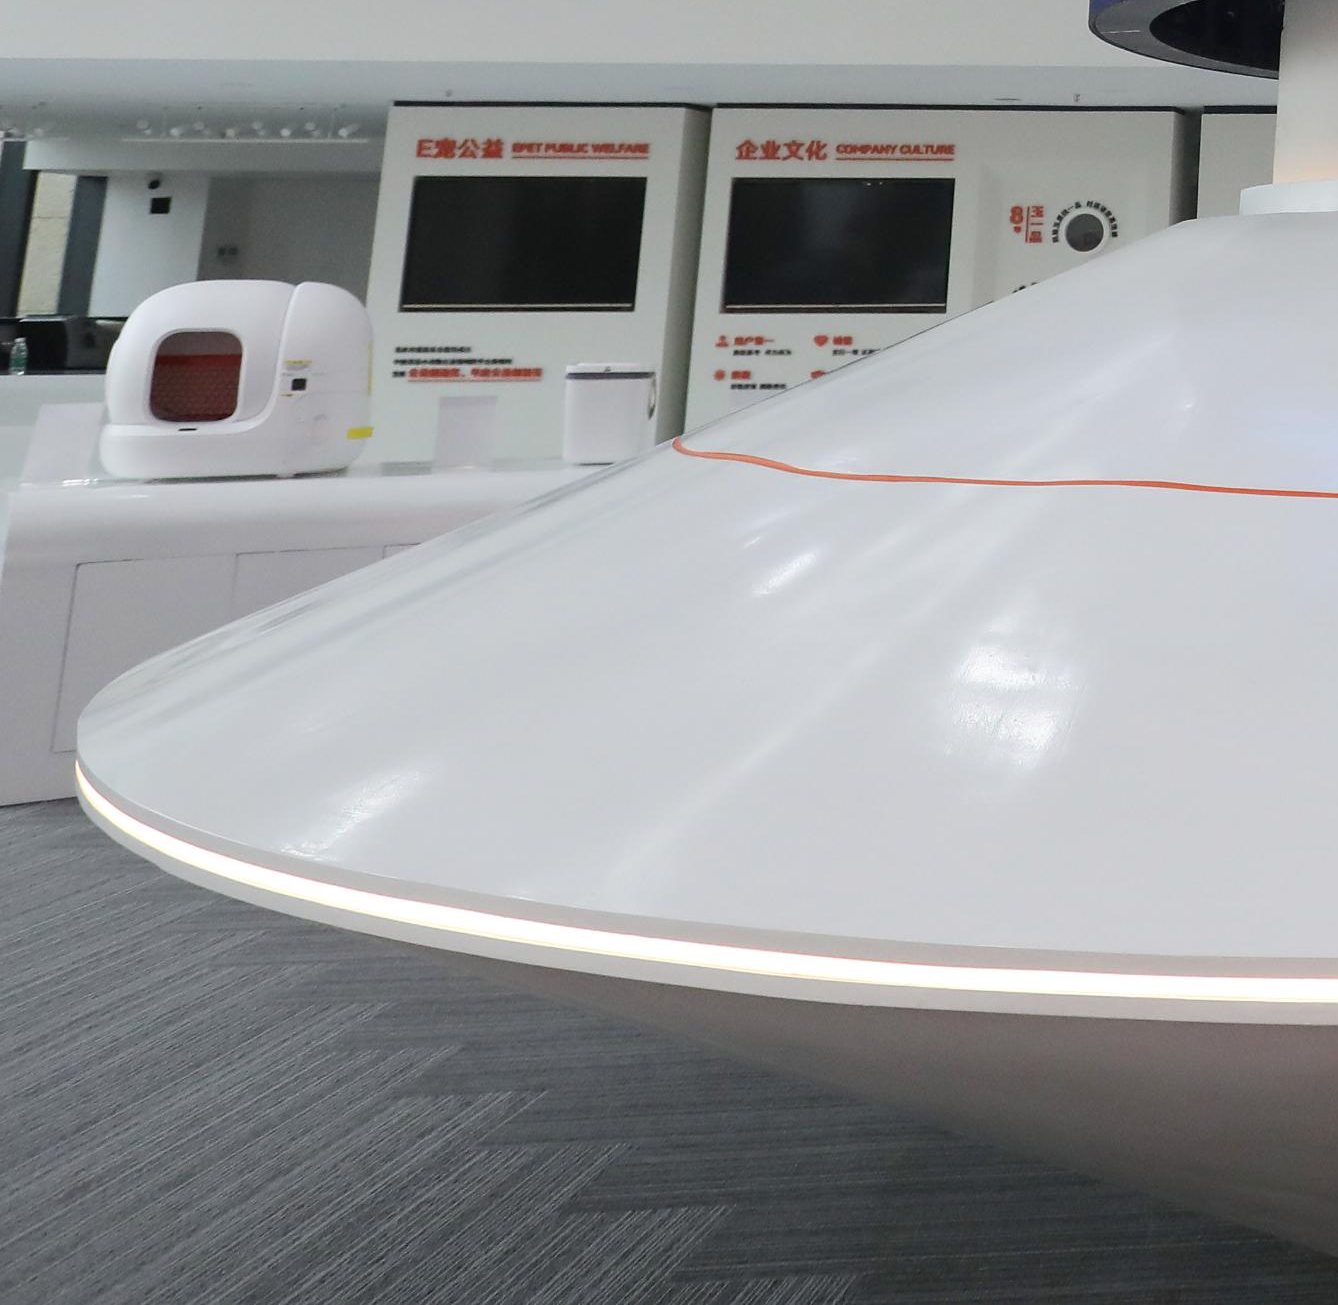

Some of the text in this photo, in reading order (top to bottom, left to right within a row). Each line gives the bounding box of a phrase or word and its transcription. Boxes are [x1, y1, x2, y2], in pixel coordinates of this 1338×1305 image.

[735, 140, 956, 161] 企业文化 COMPANY CULTURE
